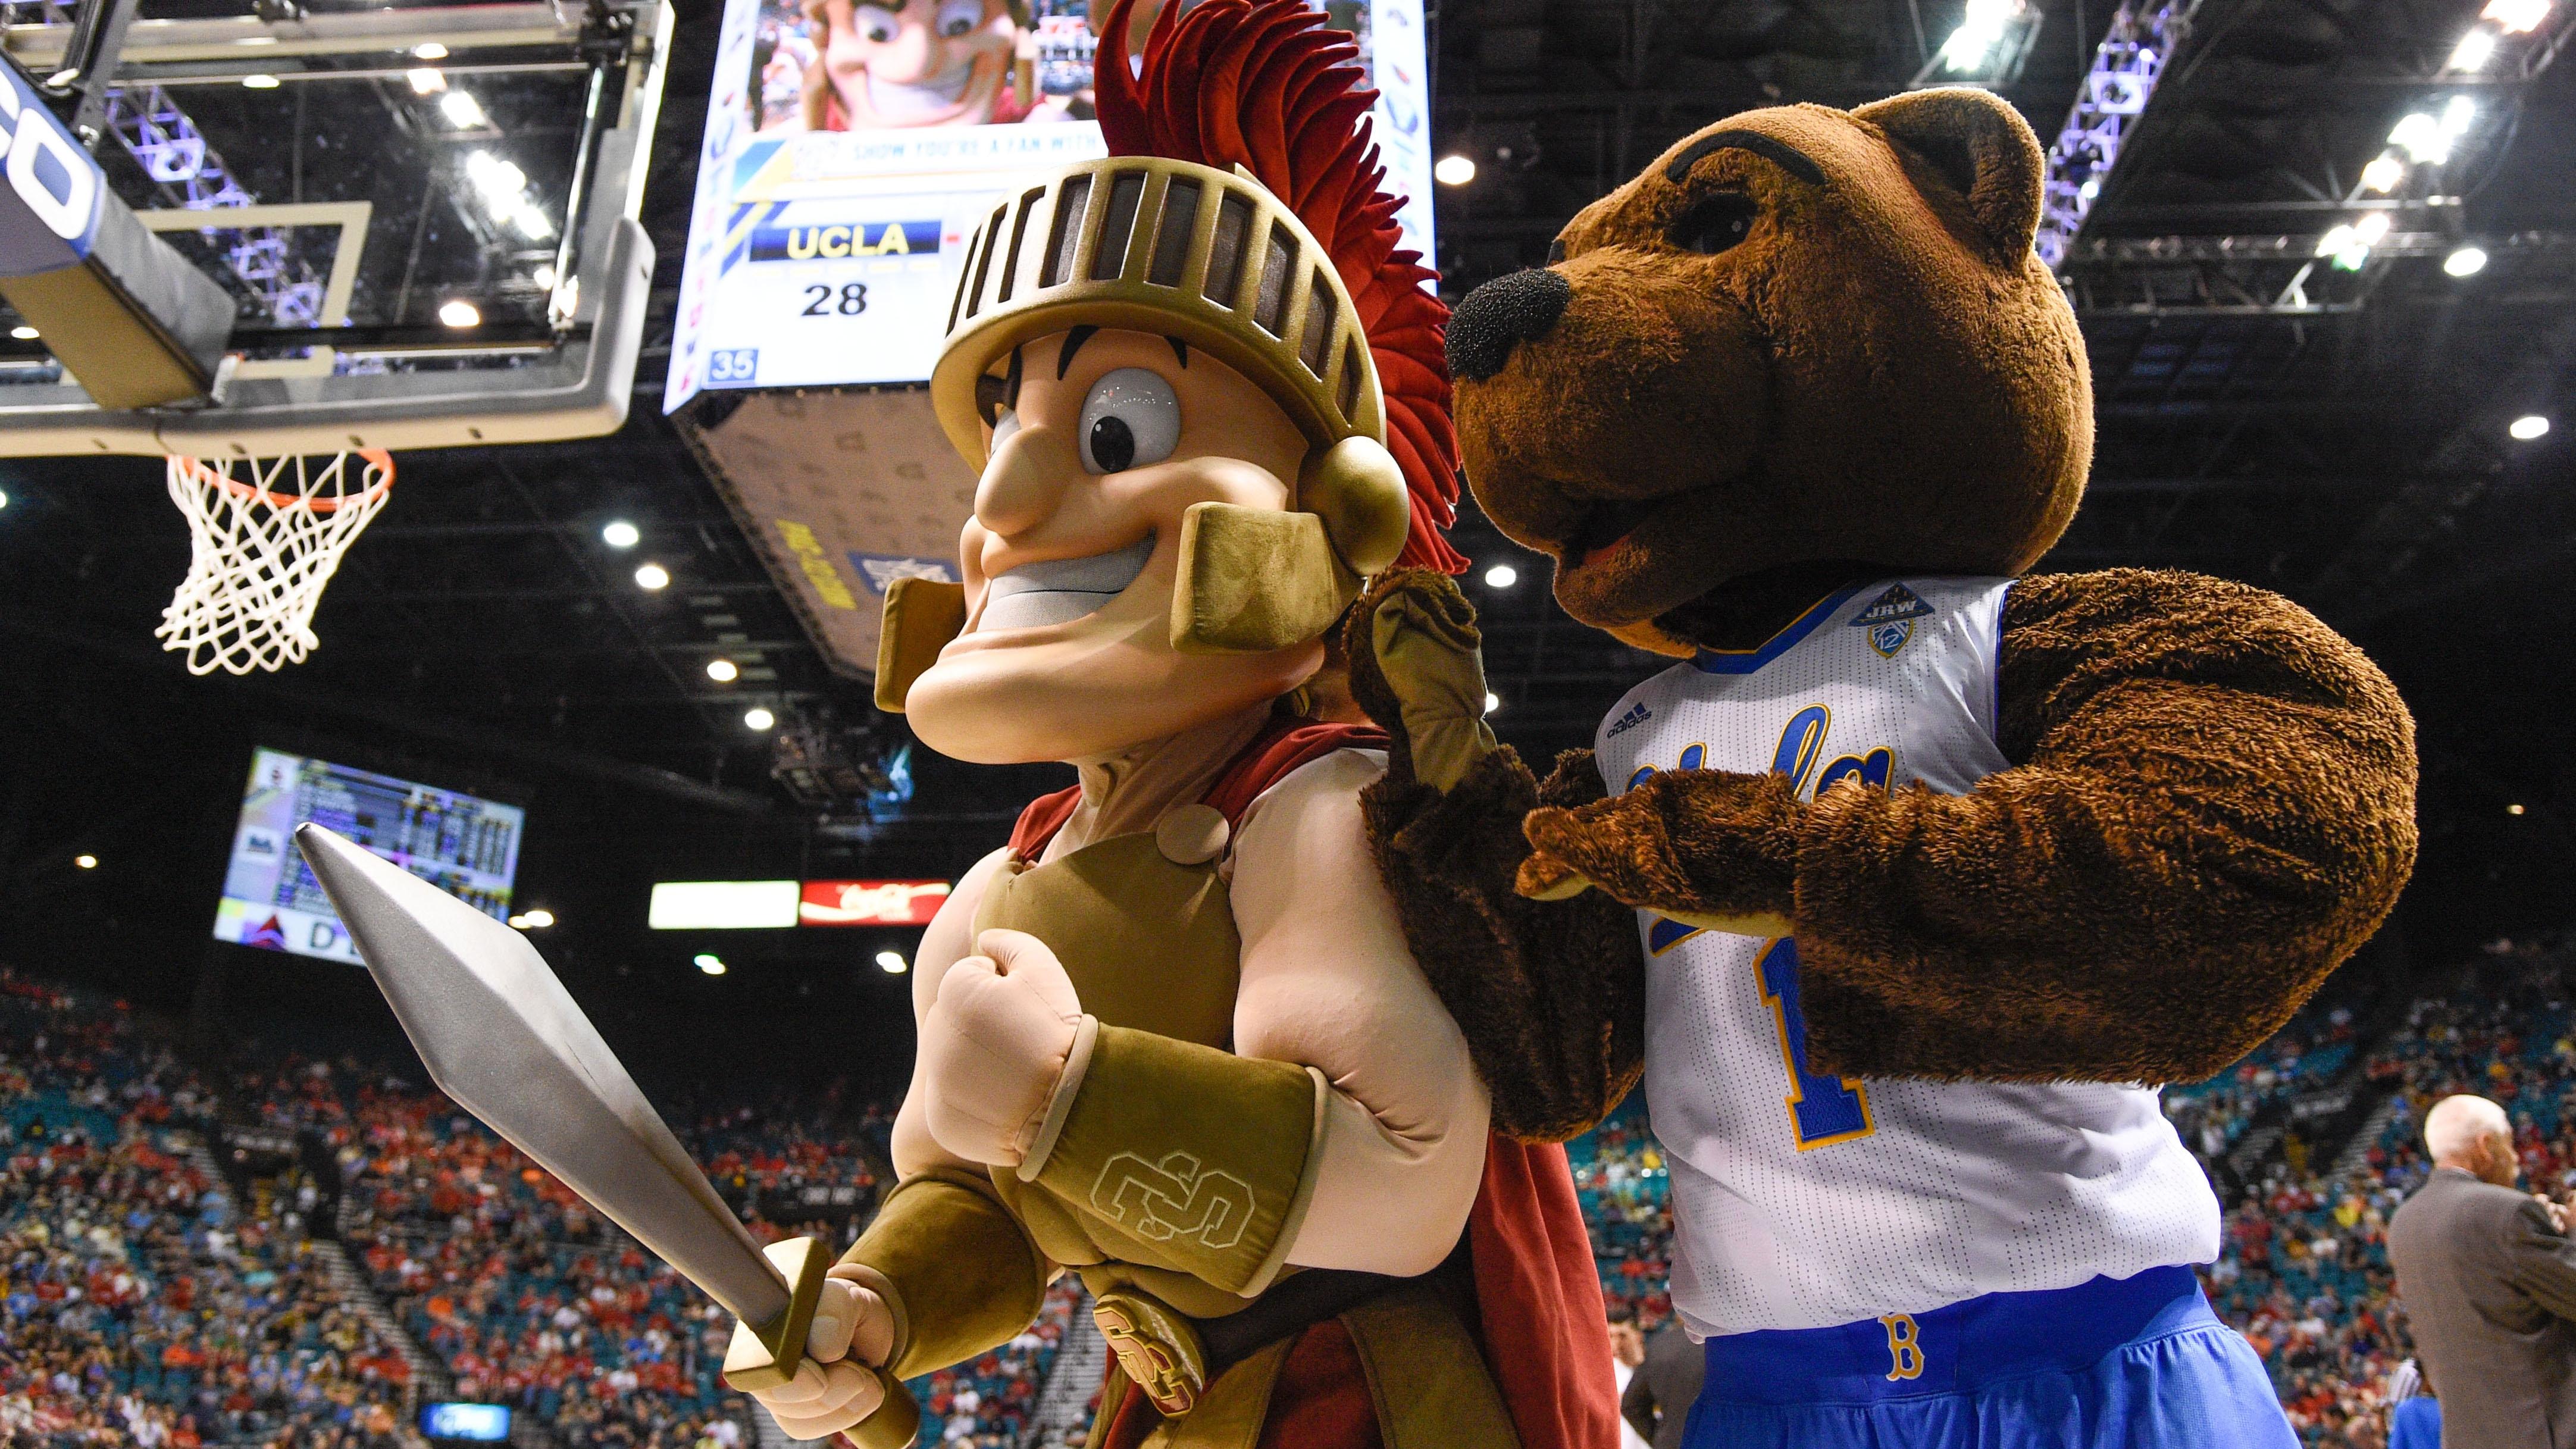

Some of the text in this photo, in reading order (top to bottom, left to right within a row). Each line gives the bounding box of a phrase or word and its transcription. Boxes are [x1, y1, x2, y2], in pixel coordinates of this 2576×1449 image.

[853, 143, 904, 161] SHOW
[990, 138, 1000, 156] A
[1008, 136, 1041, 154] FAN
[1051, 134, 1097, 152] WITH
[787, 223, 910, 259] UCLA
[801, 283, 868, 317] 28
[710, 351, 755, 381] 35
[1866, 600, 1917, 618] JRW
[1879, 633, 1900, 650] 12
[1607, 711, 1652, 738] adidas
[1877, 1313, 1926, 1381] B
